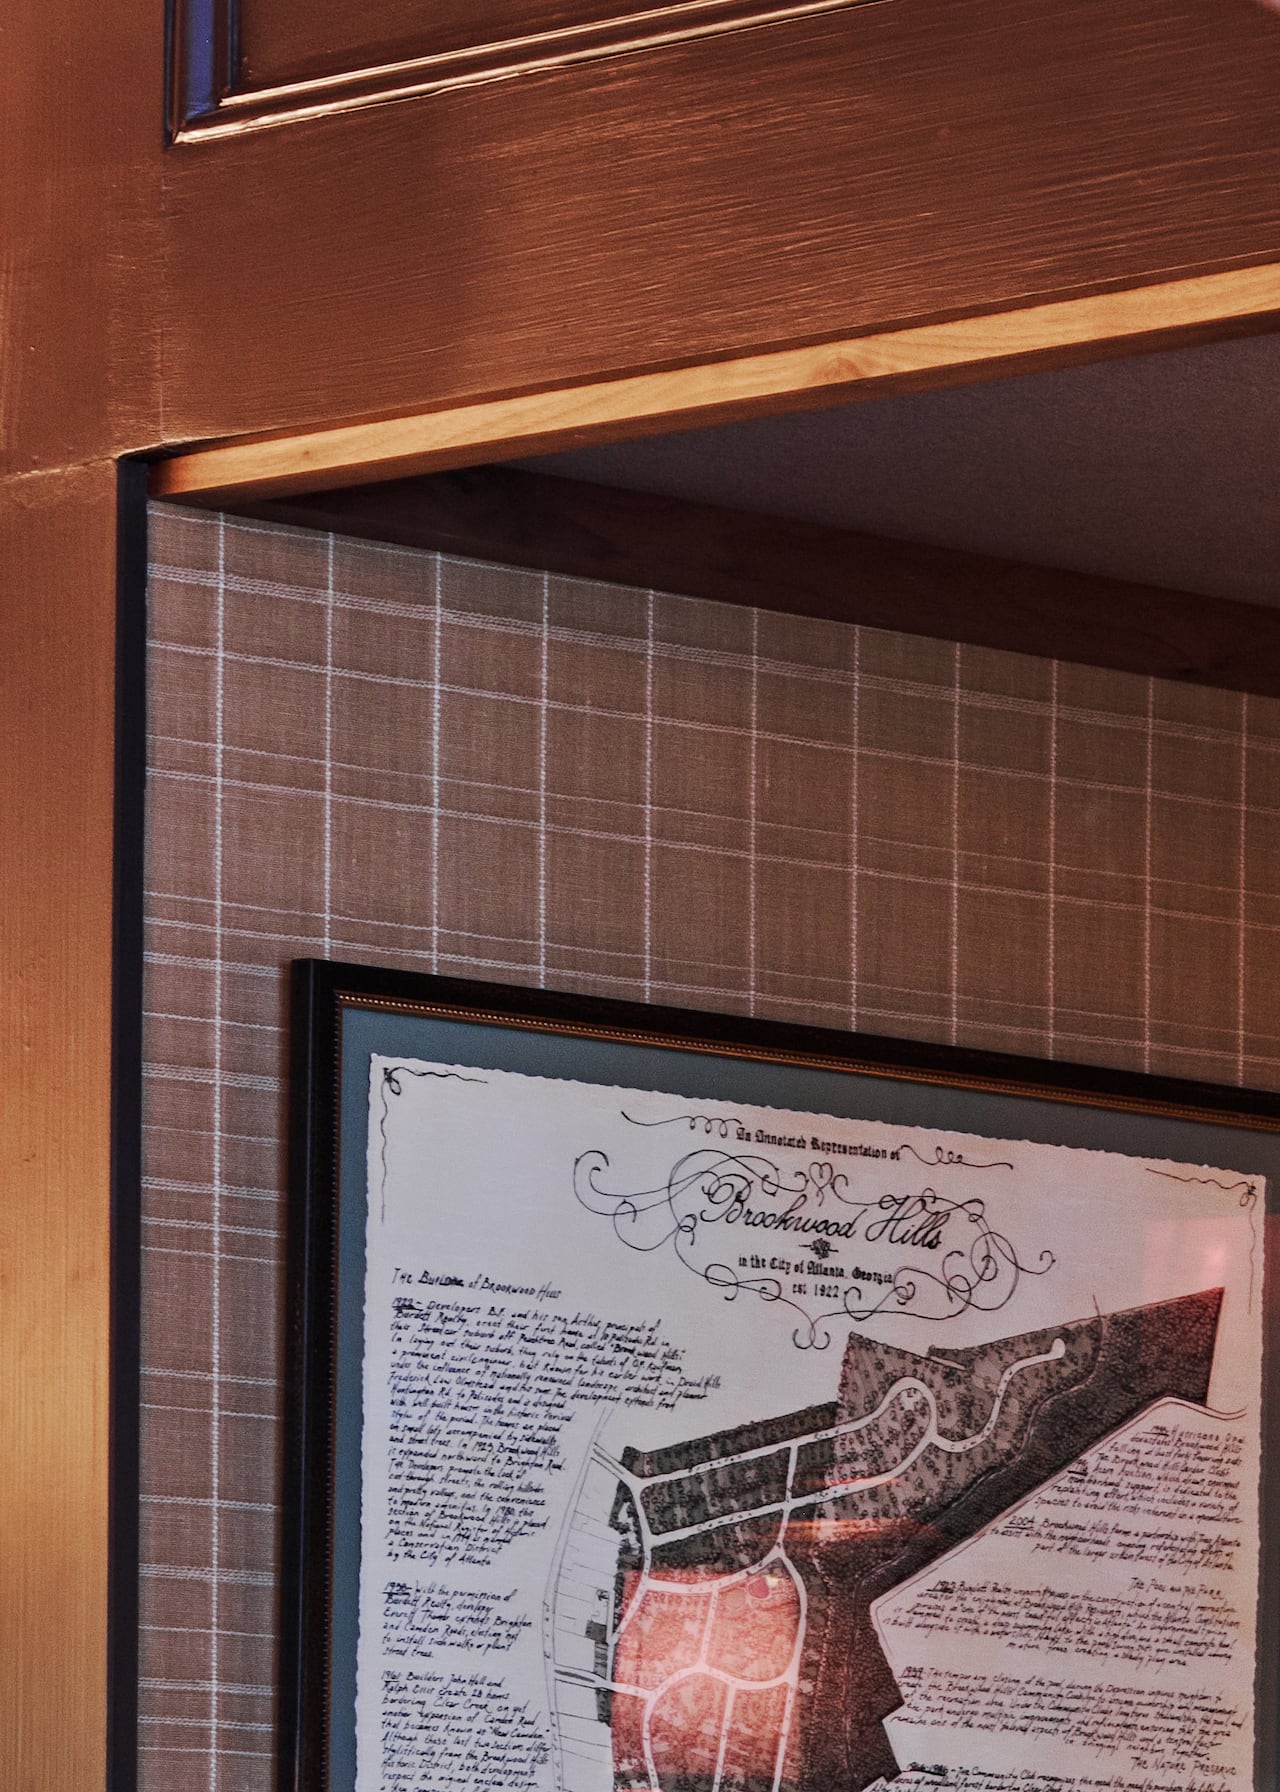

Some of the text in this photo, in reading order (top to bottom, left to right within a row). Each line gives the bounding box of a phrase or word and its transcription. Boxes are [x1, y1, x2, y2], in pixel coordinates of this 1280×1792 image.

[736, 1127, 901, 1161] An Annotated Representation of
[700, 1172, 952, 1250] Brookwood Hills
[738, 1257, 748, 1267] in
[750, 1255, 766, 1269] the
[769, 1258, 791, 1275] City
[794, 1261, 804, 1274] of
[851, 1268, 894, 1286] Georgia
[814, 1284, 839, 1298] 1922
